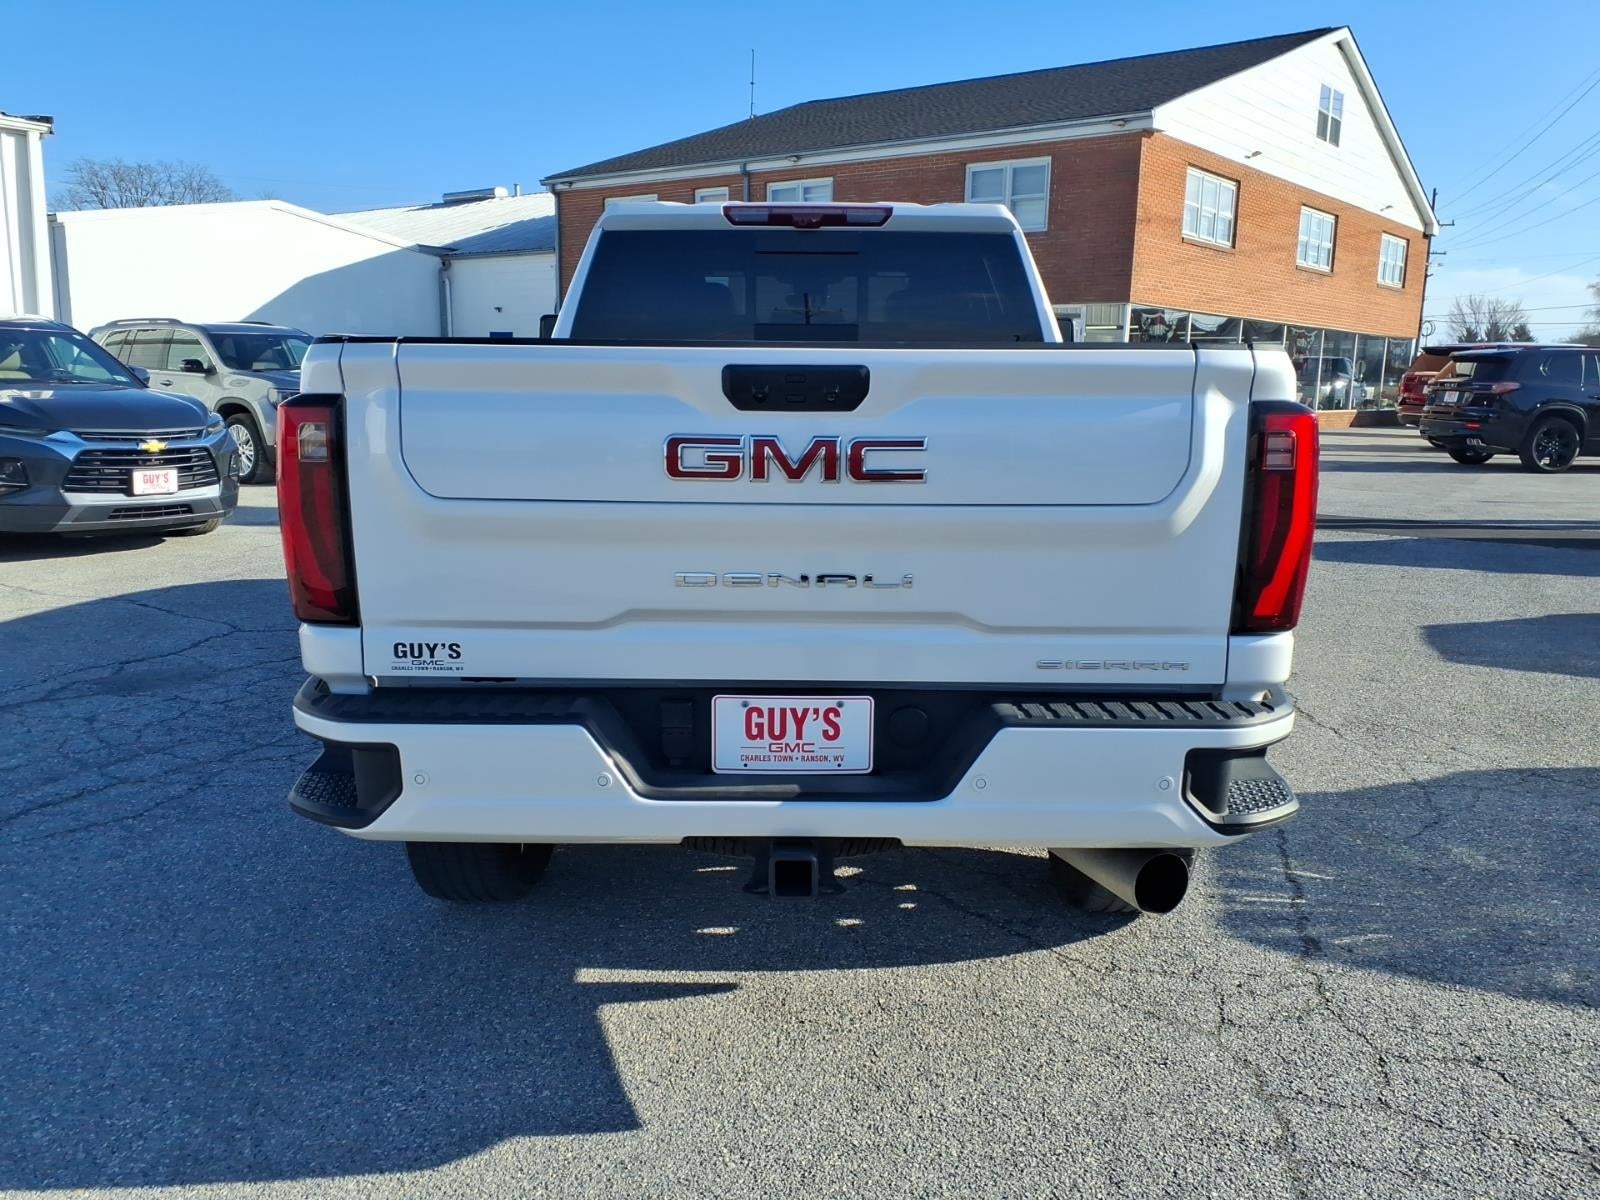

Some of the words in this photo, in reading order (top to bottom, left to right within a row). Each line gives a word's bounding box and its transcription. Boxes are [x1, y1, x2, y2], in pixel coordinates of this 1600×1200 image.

[664, 433, 928, 484] GMC
[674, 572, 913, 588] DENALI
[393, 642, 461, 659] GUY'S
[1036, 660, 1190, 671] SIERRA
[744, 706, 841, 741] GUY'S
[768, 742, 815, 753] GMC
[801, 755, 831, 763] RANSON,
